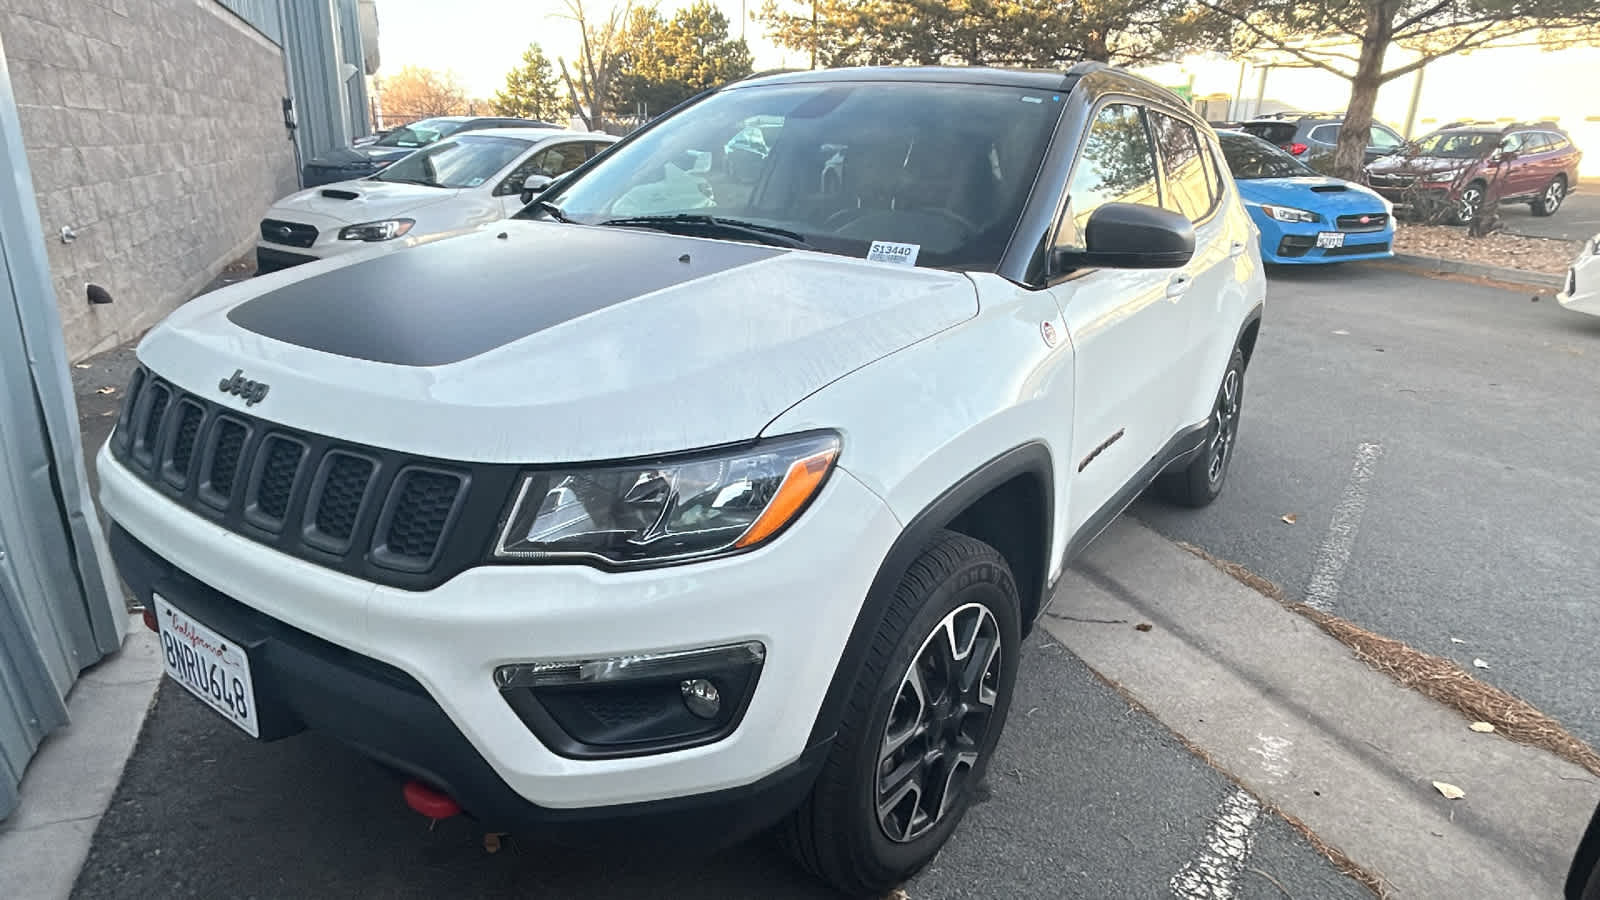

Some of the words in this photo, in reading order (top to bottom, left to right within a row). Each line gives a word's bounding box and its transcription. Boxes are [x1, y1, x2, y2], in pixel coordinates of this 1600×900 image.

[872, 244, 911, 256] S13440
[219, 369, 270, 407] Jeep
[171, 613, 223, 657] California
[163, 629, 248, 719] 8NRU648
